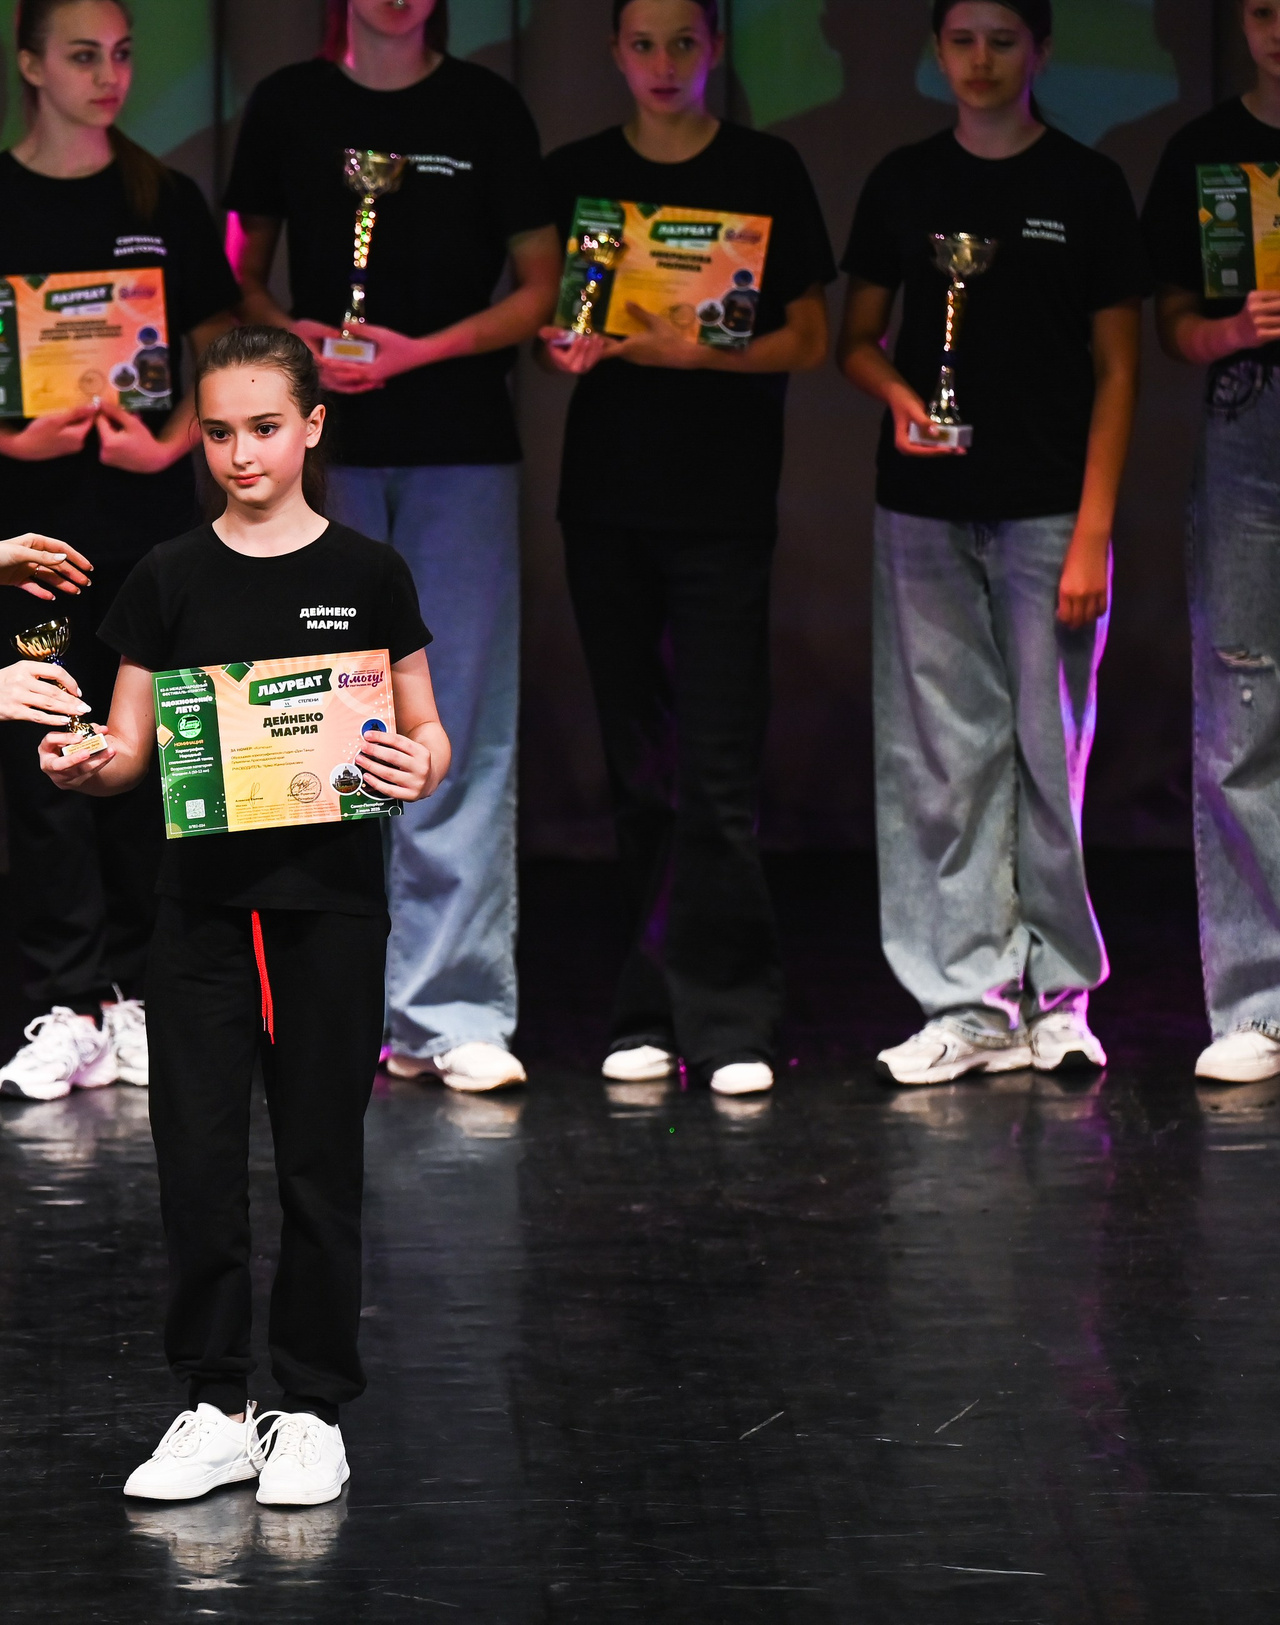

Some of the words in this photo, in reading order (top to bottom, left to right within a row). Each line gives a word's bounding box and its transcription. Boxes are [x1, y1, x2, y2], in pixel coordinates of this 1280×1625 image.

[299, 605, 357, 618] ДЕЙНЕКО
[306, 620, 349, 631] МАРИЯ
[258, 675, 323, 697] ЛАУРЕАТ
[175, 704, 201, 715] ЛЕТО
[263, 712, 324, 728] ДЕЙНЕКО
[271, 724, 318, 738] МАРИЯ
